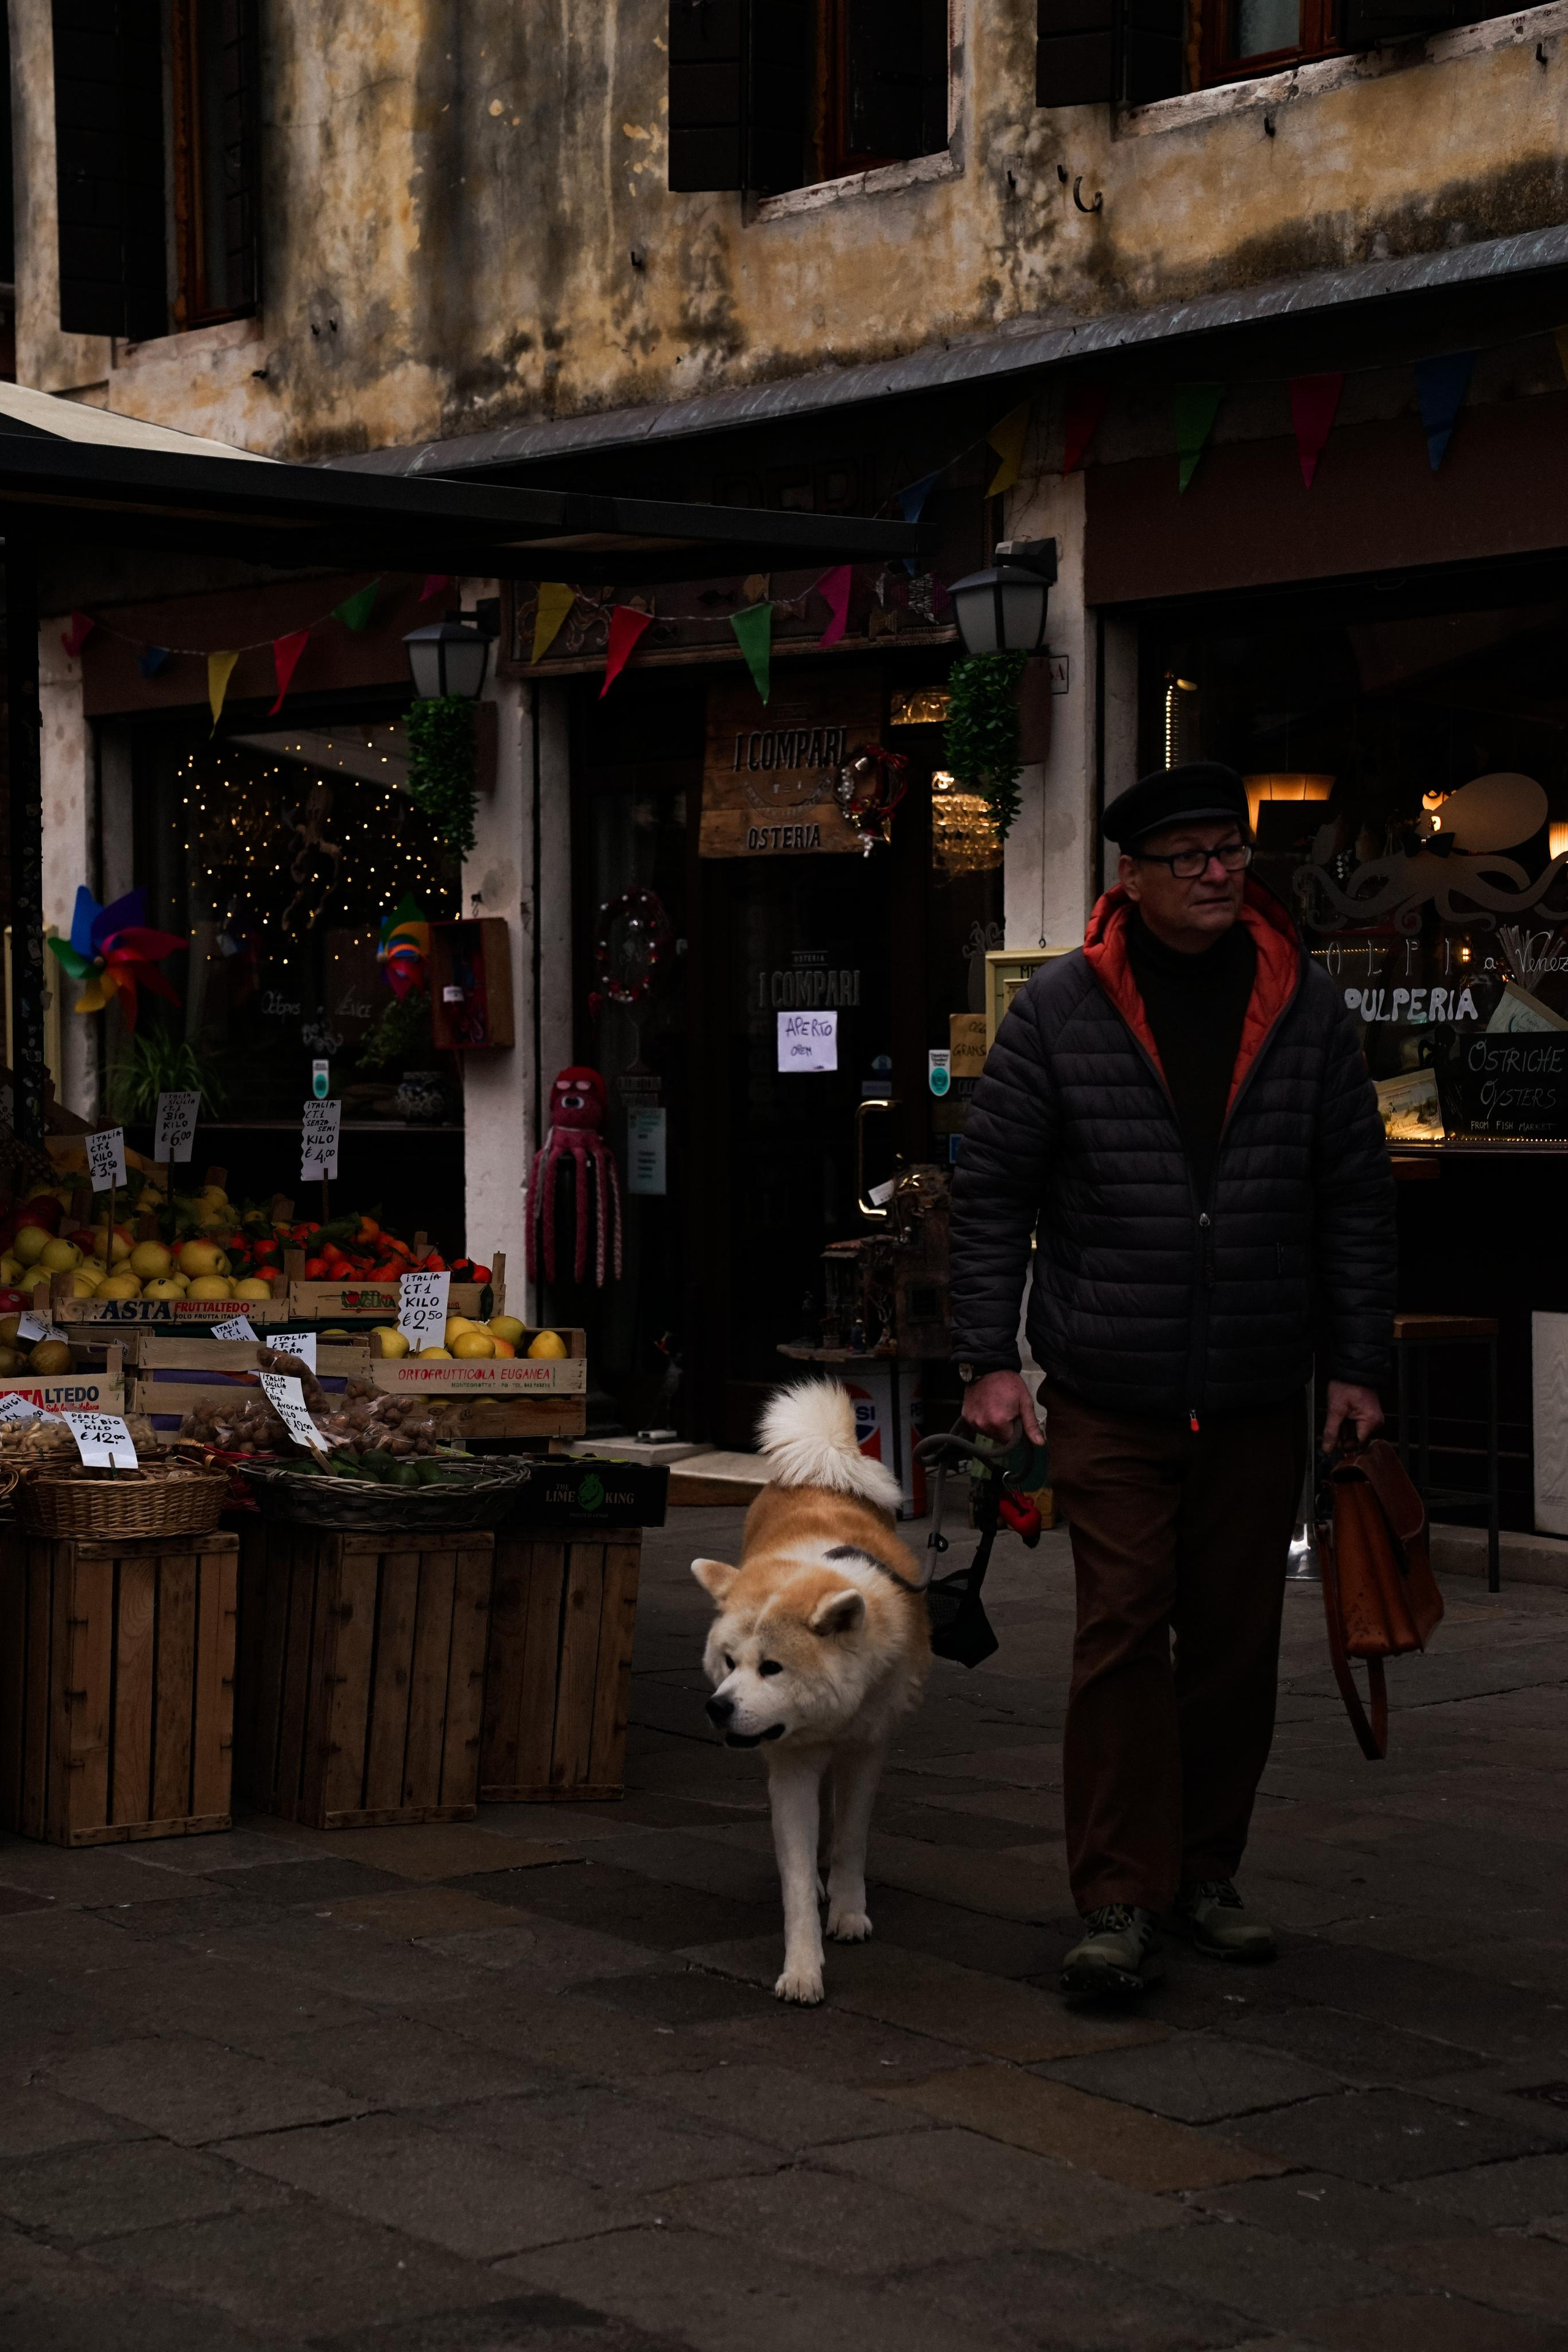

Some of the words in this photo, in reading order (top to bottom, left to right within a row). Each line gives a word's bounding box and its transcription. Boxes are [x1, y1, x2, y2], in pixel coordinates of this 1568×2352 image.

[733, 733, 744, 772] I
[747, 725, 848, 771] COMPARI
[747, 823, 822, 850] OSTERIA
[793, 954, 825, 963] OSTERIA
[1516, 932, 1568, 973] Venez
[759, 971, 766, 1008] I
[771, 970, 861, 1008] COMPARI
[1344, 987, 1479, 1022] PULPERIA
[785, 1017, 833, 1037] APERTO
[952, 1044, 987, 1057] GRANS
[1468, 1039, 1565, 1073] OSTRICHE
[1480, 1078, 1556, 1120] OYSTERS
[163, 1121, 187, 1129] KILO
[1471, 1121, 1489, 1130] FROM
[1496, 1121, 1513, 1131] FISH
[1518, 1122, 1558, 1132] MARKET
[307, 1134, 334, 1145] KILO
[92, 1151, 113, 1164] KILO
[406, 1297, 440, 1307] KILO
[100, 1300, 172, 1319] ASTA
[174, 1302, 250, 1313] FRUTTALTEDO
[398, 1368, 495, 1380] ORTOFRUTTICOLA
[500, 1368, 550, 1380] EUGANEA
[277, 1401, 307, 1412] AVOCADO
[279, 1409, 296, 1419] KILO
[545, 1490, 576, 1503] LIME
[605, 1491, 635, 1505] KING
